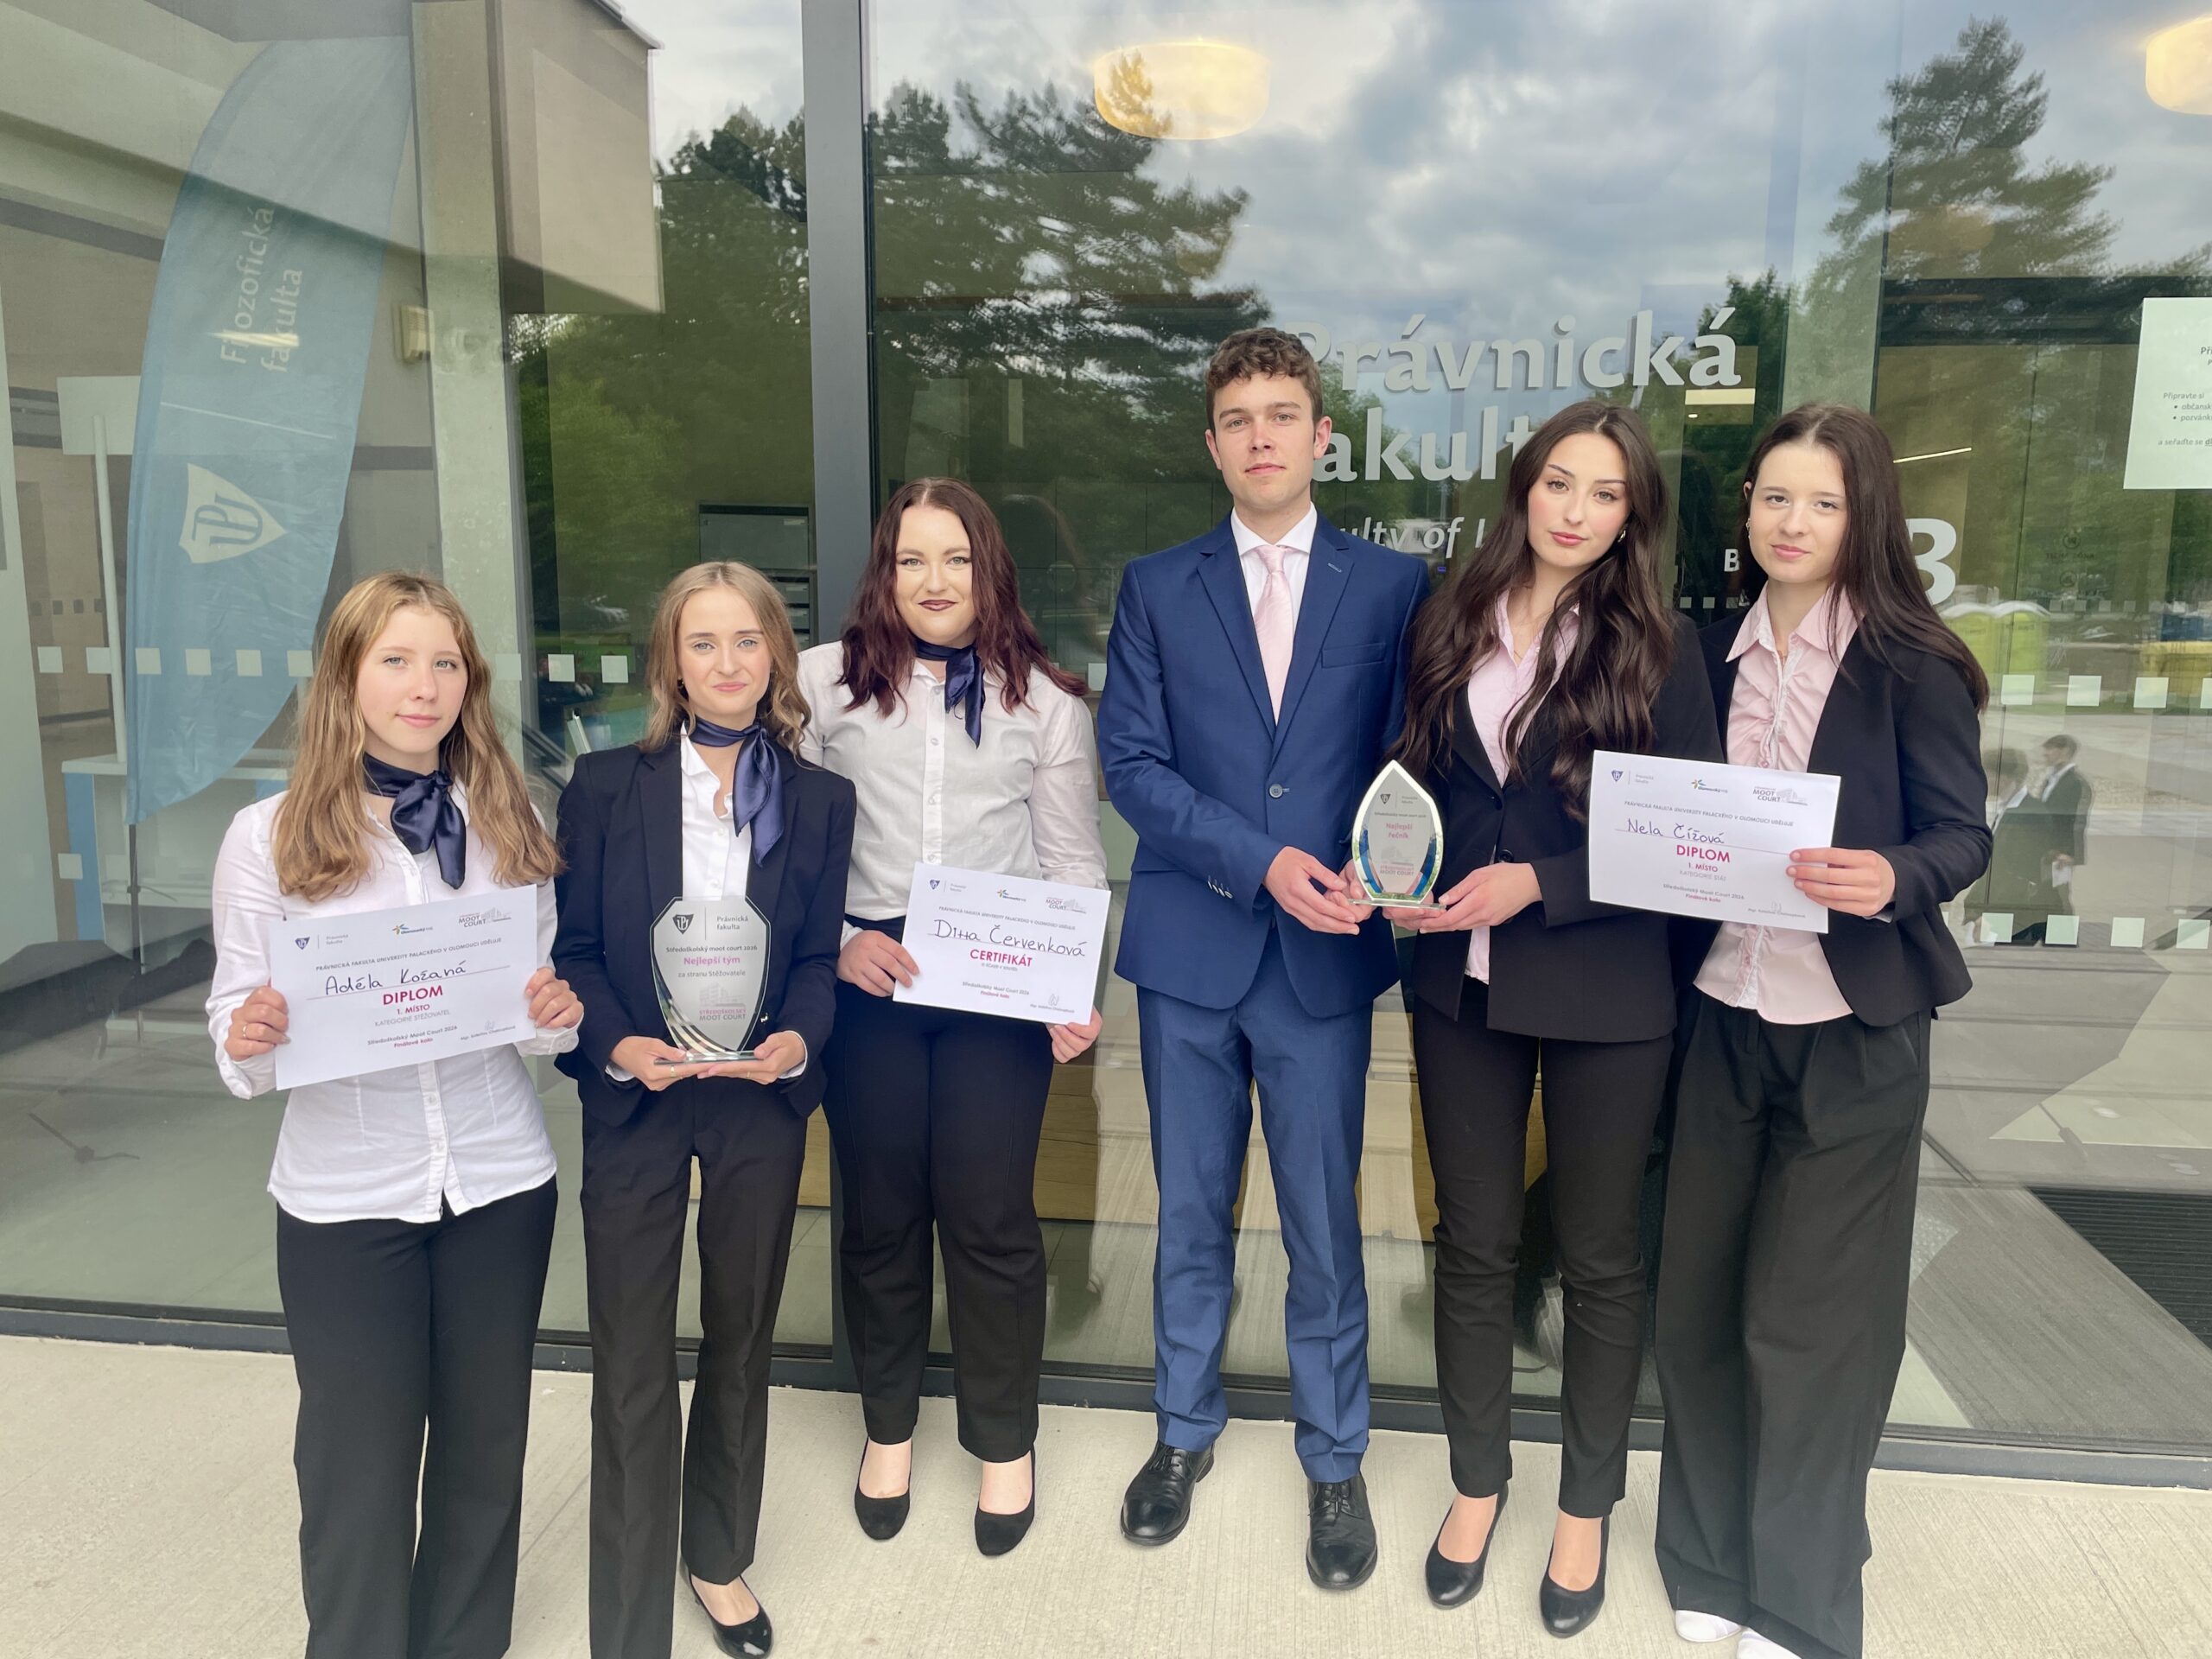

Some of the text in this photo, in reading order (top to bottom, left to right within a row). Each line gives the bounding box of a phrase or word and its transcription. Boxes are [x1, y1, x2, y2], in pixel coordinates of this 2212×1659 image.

[220, 207, 276, 364] Fiozofická
[1285, 307, 1742, 391] Právnická
[1313, 406, 1536, 481] akult
[1423, 517, 1465, 559] of
[1753, 788, 1776, 797] MOOT
[1628, 817, 1664, 836] Nela
[1676, 844, 1731, 862] DIPLOM
[1695, 863, 1718, 873] MÍSTO
[458, 914, 480, 924] MOOT
[464, 918, 486, 928] COURT
[448, 942, 480, 951] OLOMOUCI
[989, 924, 1087, 957] Červenková
[683, 956, 741, 966] Nejlepší tým
[969, 949, 1033, 967] CERTIFIKÁT
[383, 984, 443, 1005] DIPLOM
[404, 1003, 430, 1014] MÍSTO
[374, 1016, 412, 1027] KATEGORIE
